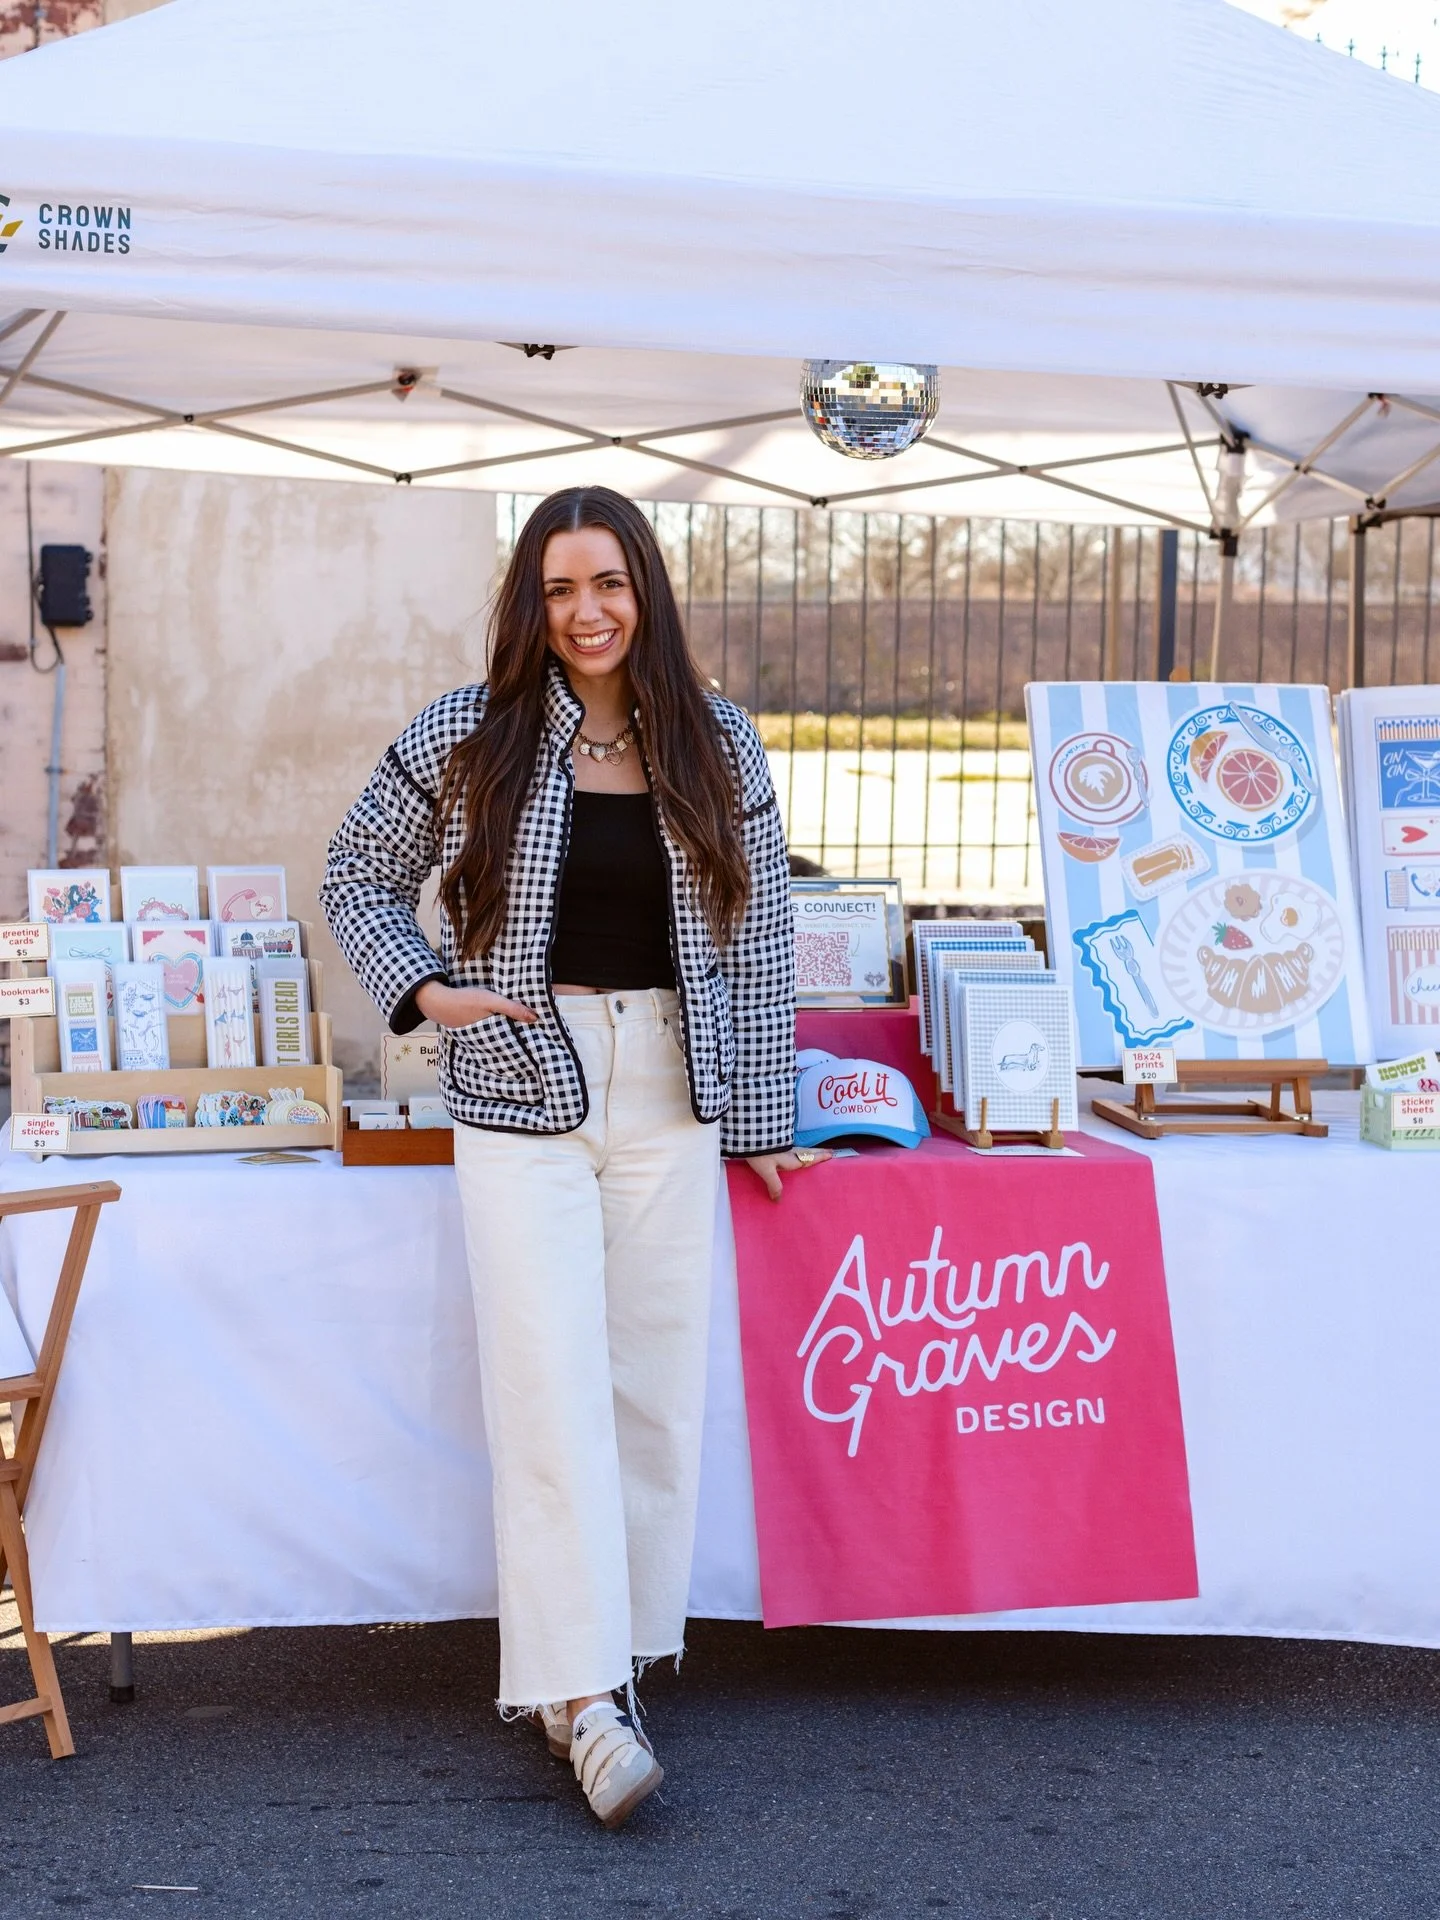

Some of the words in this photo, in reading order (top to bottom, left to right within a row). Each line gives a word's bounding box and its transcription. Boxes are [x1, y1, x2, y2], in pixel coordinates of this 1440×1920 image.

[39, 203, 131, 229] CROWN
[38, 228, 130, 254] SHADES
[1383, 748, 1404, 766] CIN
[1386, 761, 1408, 778] CIN
[804, 902, 876, 913] CONNECT!
[2, 929, 40, 939] greeting
[9, 938, 34, 946] cards
[16, 949, 28, 957] $5
[1410, 977, 1440, 994] chee
[0, 987, 50, 997] bookmarks
[274, 981, 298, 1012] READ
[18, 998, 30, 1006] $3
[276, 1017, 300, 1052] GIRLS
[420, 1046, 440, 1055] Buil
[1132, 1052, 1161, 1061] 18x24
[1135, 1061, 1164, 1071] prints
[1377, 1057, 1427, 1081] HOWDY
[818, 1072, 870, 1110] Cool
[1401, 1097, 1435, 1106] sticker
[833, 1104, 878, 1115] COWBOY
[1401, 1105, 1435, 1114] sheets
[27, 1119, 55, 1129] single
[21, 1127, 60, 1136] stickers
[797, 1225, 1110, 1358] Autumn
[803, 1311, 1117, 1458] Graves
[956, 1397, 1106, 1434] DESIGN
